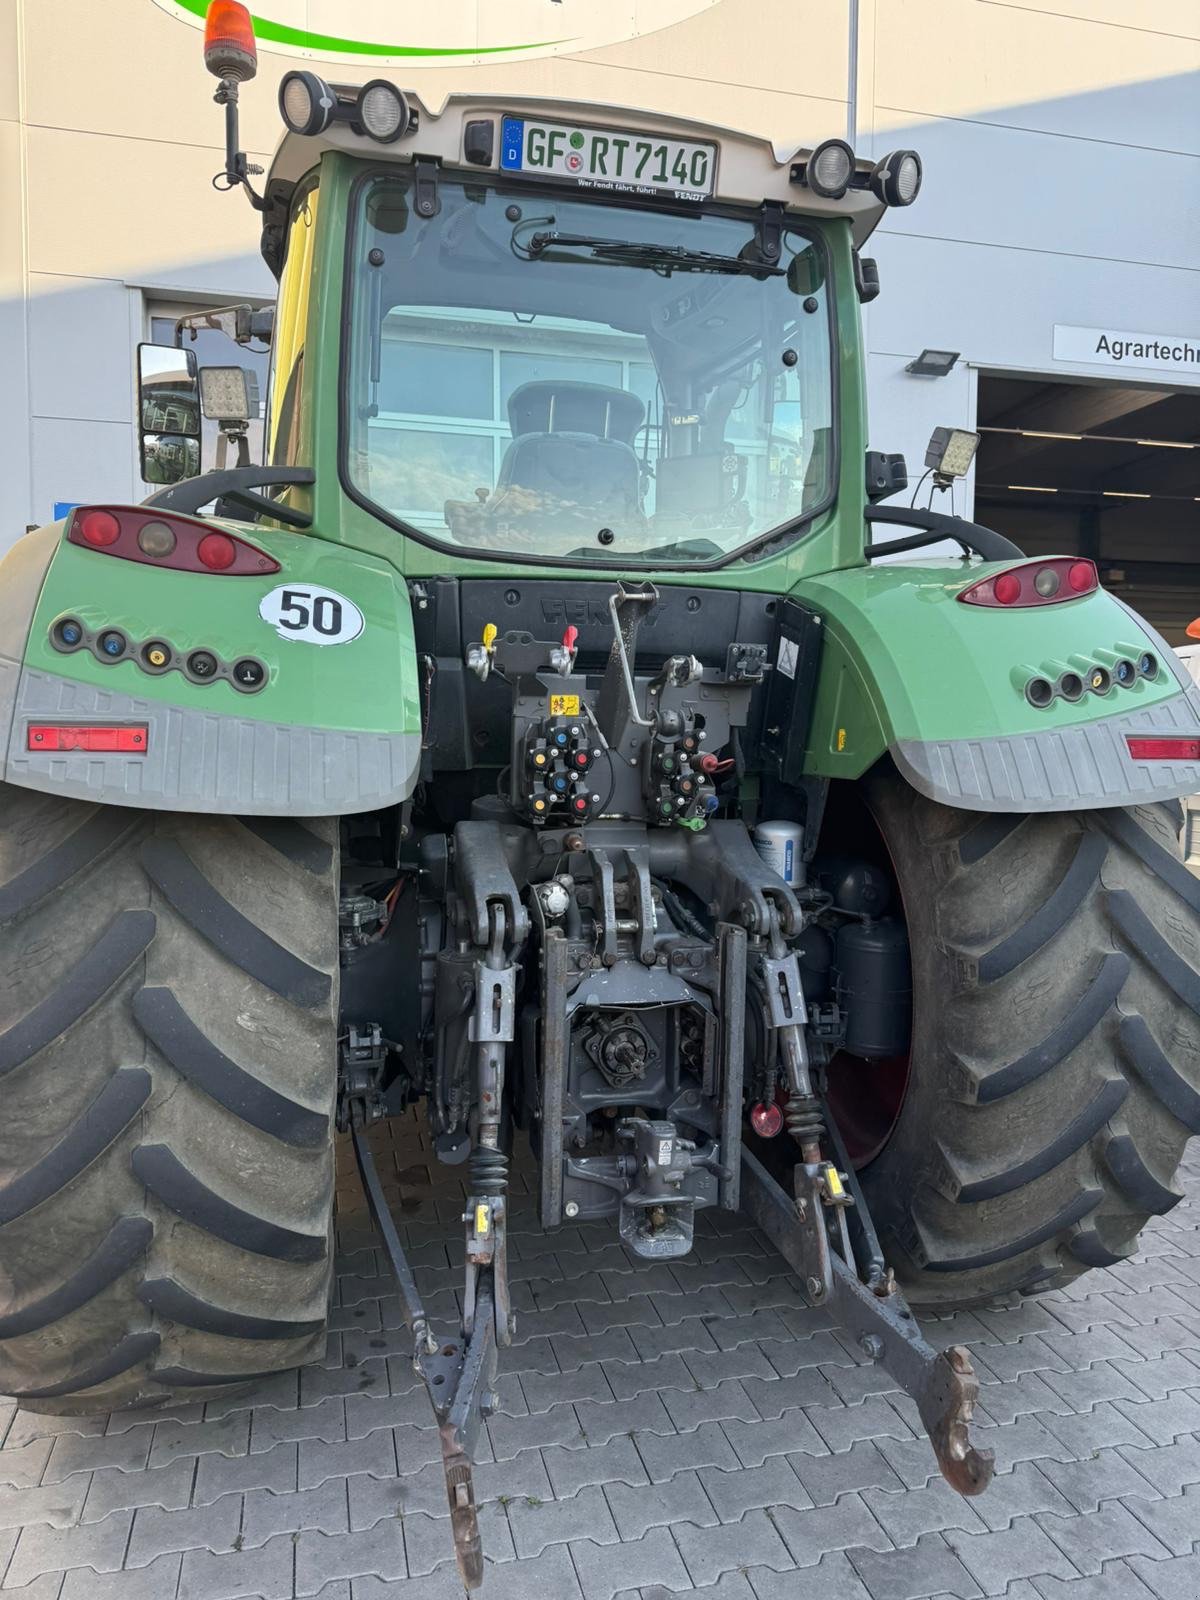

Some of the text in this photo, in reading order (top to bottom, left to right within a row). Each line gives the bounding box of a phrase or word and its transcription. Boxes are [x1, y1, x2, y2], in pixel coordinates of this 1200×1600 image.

[527, 128, 567, 168] GF
[508, 149, 517, 160] D
[577, 179, 592, 187] Wer
[593, 180, 613, 189] Fendt
[674, 190, 707, 202] FENDT
[279, 590, 342, 636] 50
